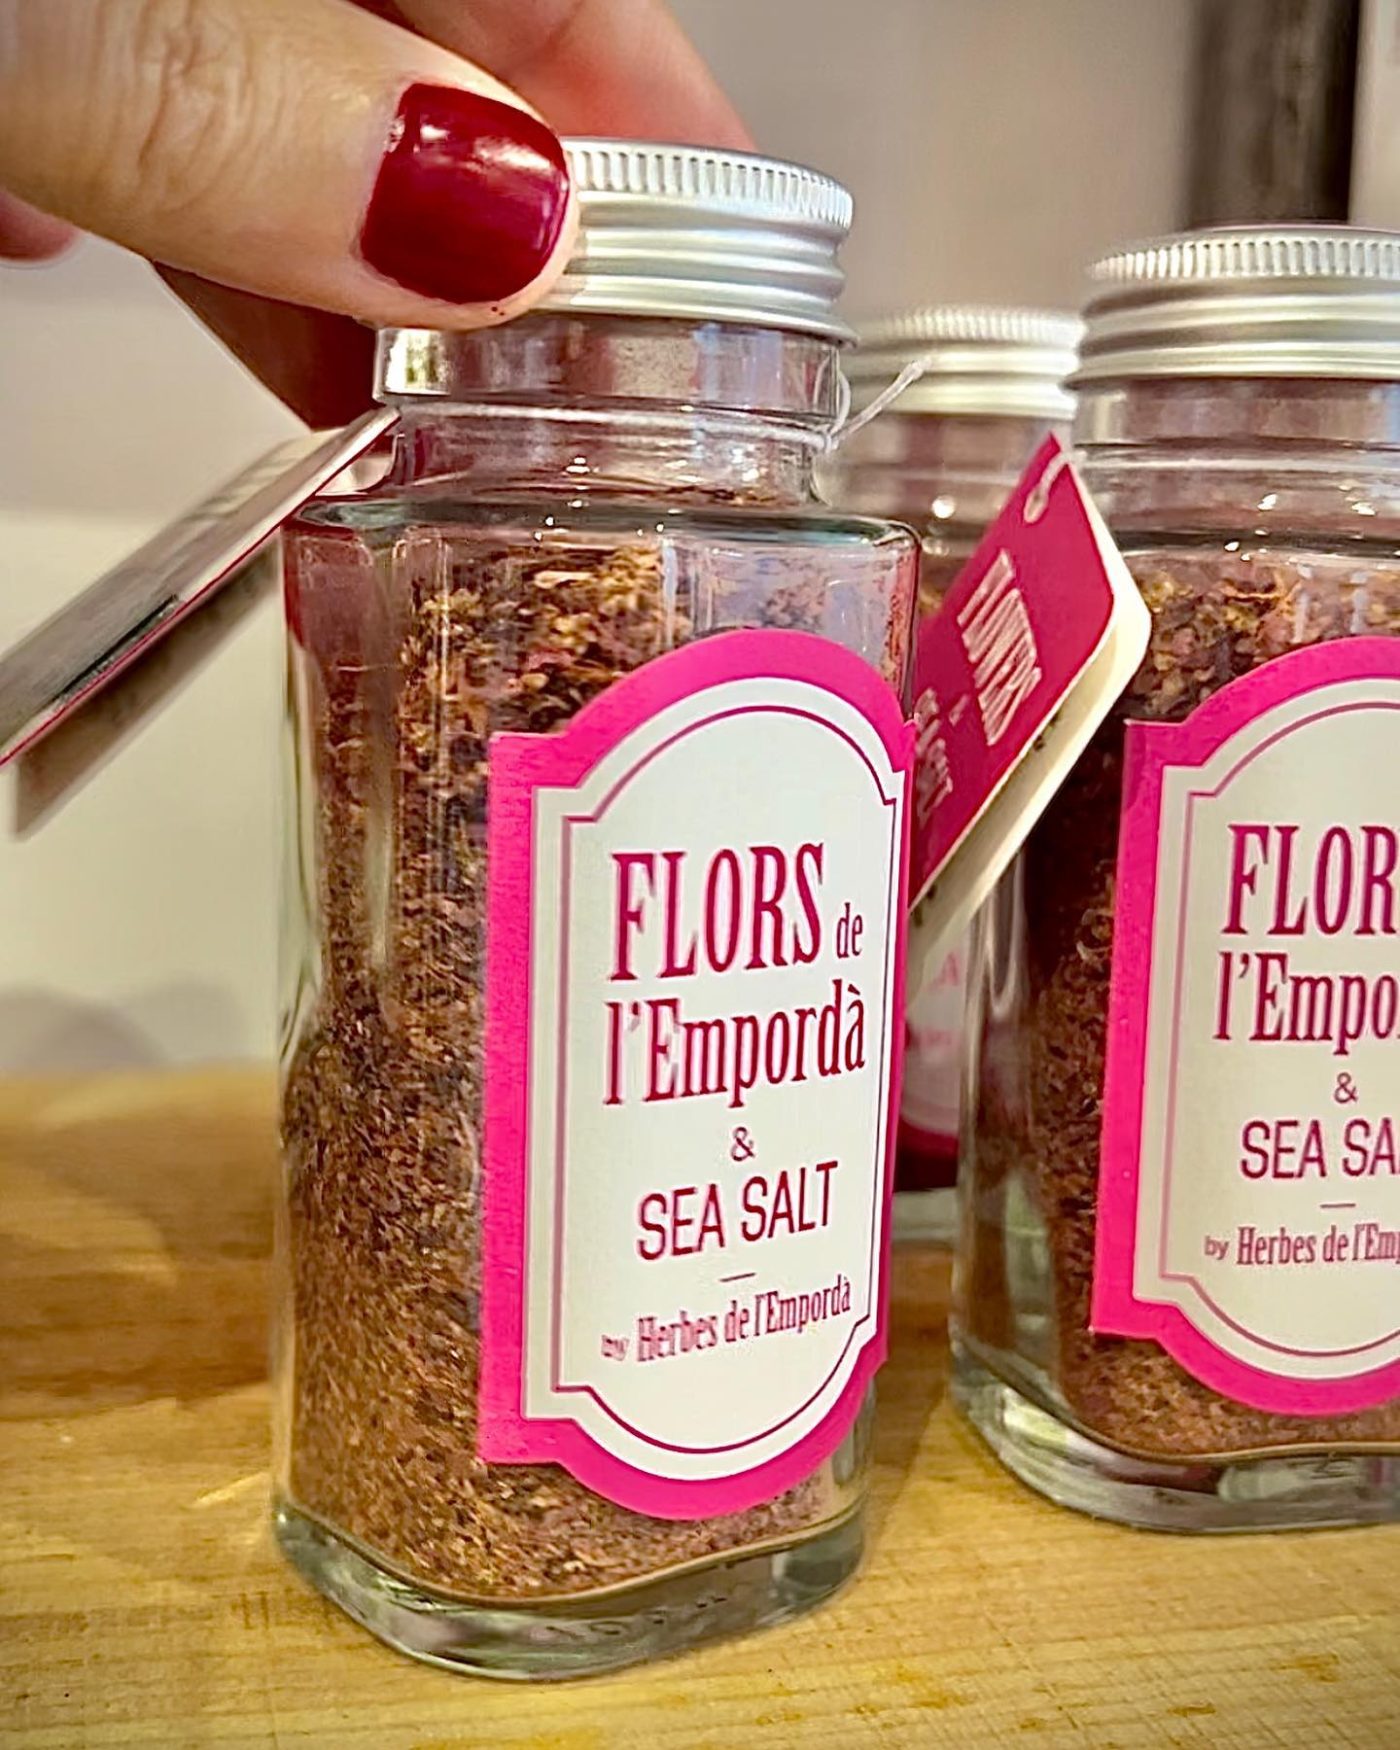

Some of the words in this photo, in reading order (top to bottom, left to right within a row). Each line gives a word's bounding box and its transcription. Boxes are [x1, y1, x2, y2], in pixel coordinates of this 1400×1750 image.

[957, 548, 1043, 747] FLOWERS
[610, 842, 825, 980] FLORS
[836, 902, 864, 960] de
[1220, 824, 1398, 936] FLOR
[602, 978, 866, 1109] l'Empordà
[1212, 951, 1400, 1056] l'Empo
[1333, 1071, 1358, 1104] &
[729, 1126, 755, 1162] &
[1239, 1118, 1327, 1179] SEA
[1341, 1116, 1400, 1177] SA
[636, 1182, 726, 1262] SEA
[740, 1160, 839, 1243] SALT
[1204, 1235, 1229, 1261] by
[1237, 1226, 1318, 1265] Herbes
[1322, 1224, 1350, 1263] de
[1352, 1222, 1400, 1264] l'Em
[637, 1310, 718, 1361] Herbes
[724, 1300, 750, 1342] de
